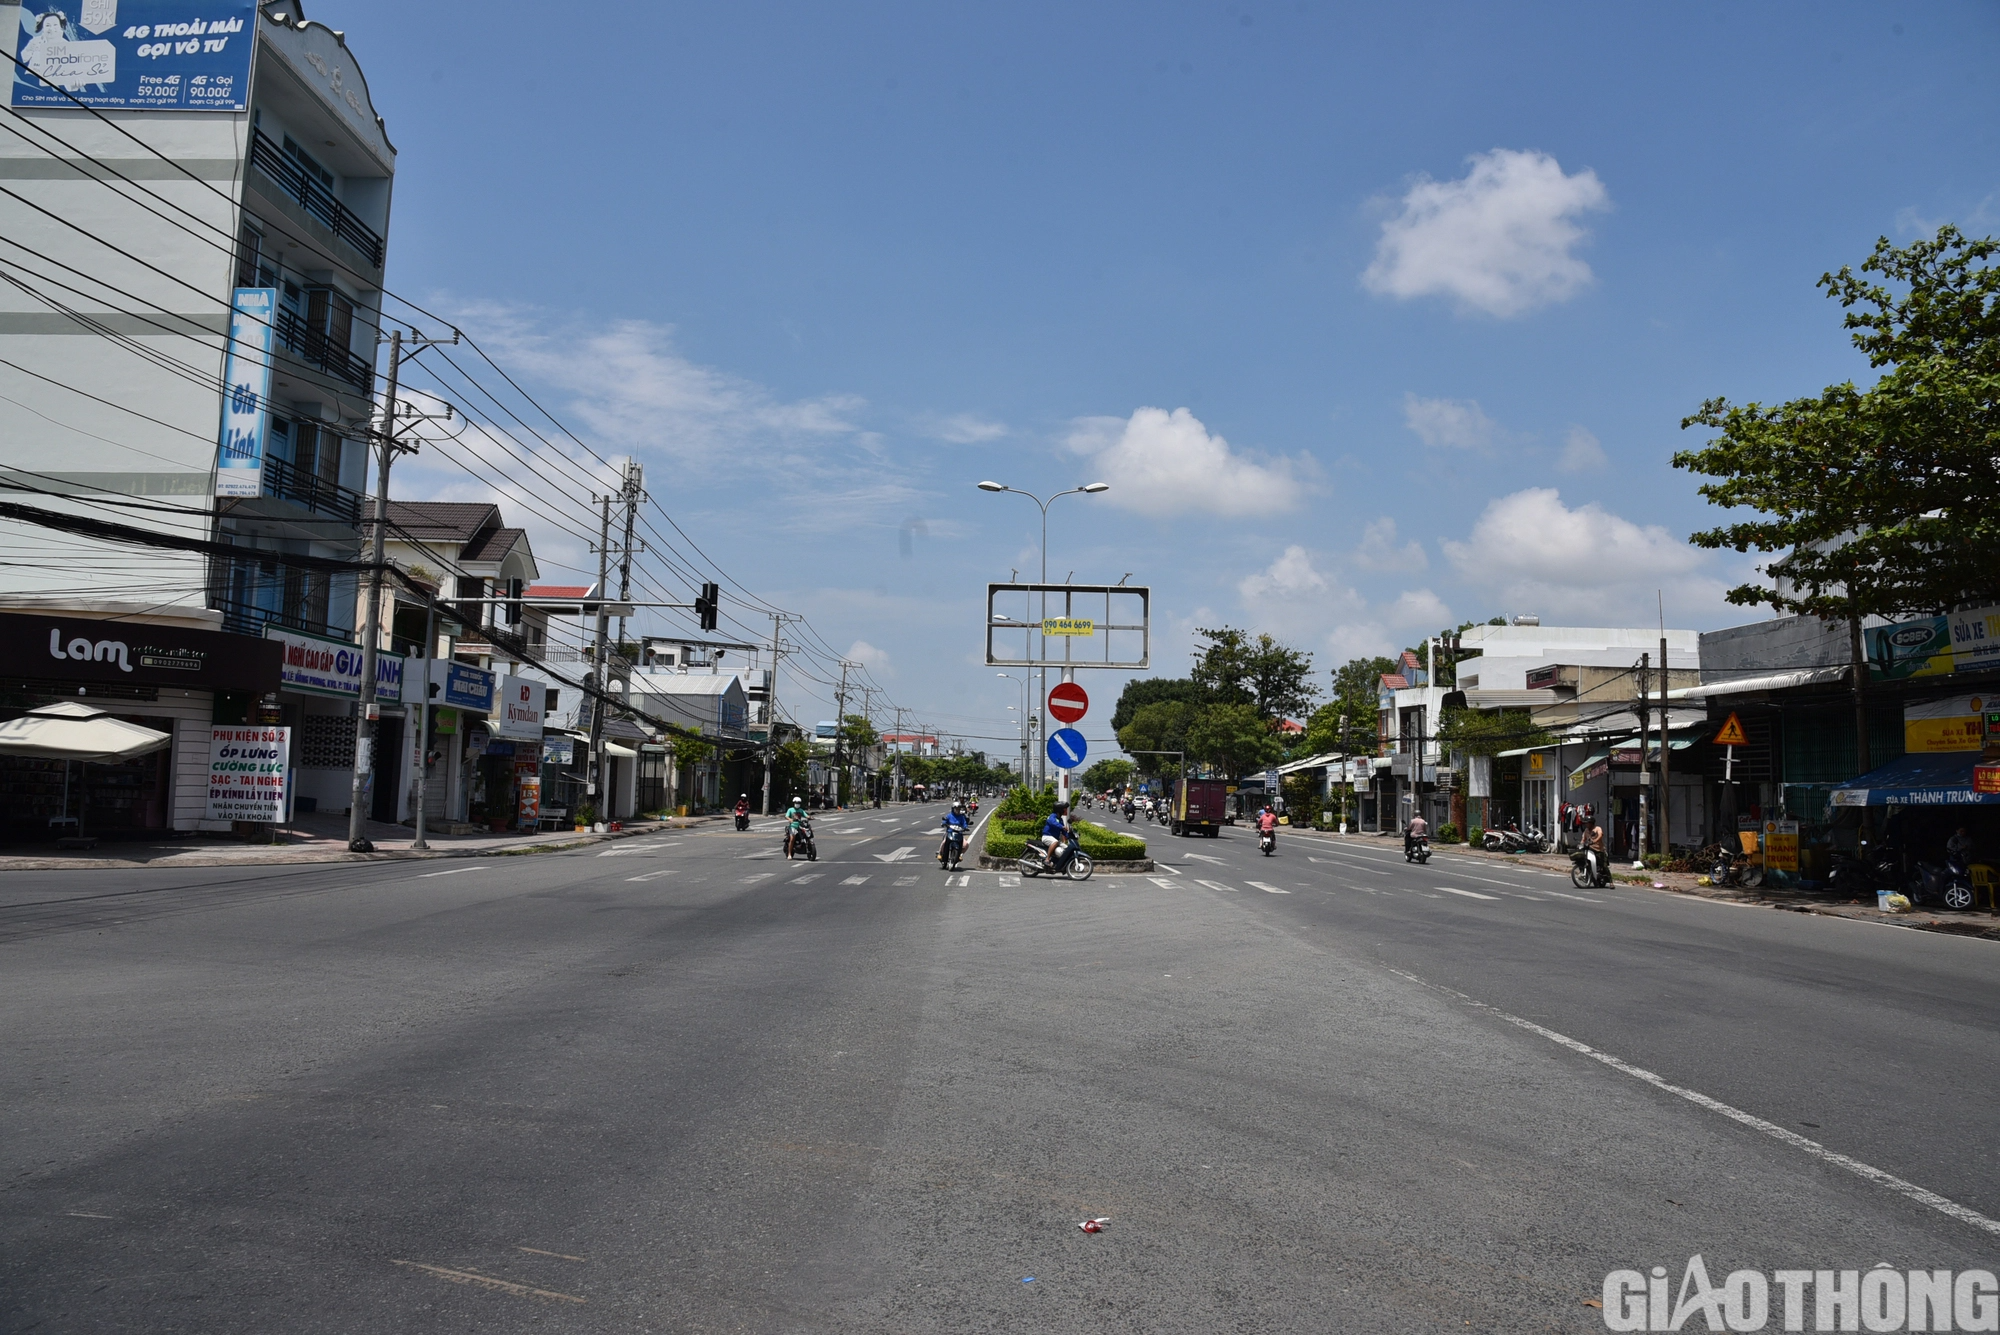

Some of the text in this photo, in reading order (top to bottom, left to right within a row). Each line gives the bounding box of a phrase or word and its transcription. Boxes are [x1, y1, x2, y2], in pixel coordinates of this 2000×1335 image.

[83, 11, 115, 25] 59K
[123, 16, 244, 39] 4G THOẢI MÁI
[46, 45, 66, 56] SIM
[137, 36, 229, 60] GỌI VÔ TƯ
[46, 53, 109, 65] mobifone
[42, 64, 83, 77] Chia
[140, 75, 181, 85] Free 4G
[190, 75, 208, 85] 4G
[216, 75, 233, 87] Gọi
[237, 292, 269, 307] NHÀ
[231, 383, 257, 415] Gia
[225, 427, 255, 460] Linh
[1044, 620, 1091, 629] 090 464 6699
[1954, 618, 1972, 643] SỬA
[1972, 621, 1985, 640] XE
[1896, 629, 1928, 644] SOBEK
[50, 628, 134, 673] Lam
[306, 649, 319, 670] CAO
[320, 646, 334, 672] CẤP
[508, 703, 539, 724] Kymdan
[213, 728, 285, 743] PHỤ KIỆN SỐ 2
[220, 744, 278, 759] ỐP LƯNG
[212, 761, 284, 775] CƯỜNG LỰC
[211, 775, 231, 786] SẠC
[239, 776, 254, 785] TAI
[257, 777, 283, 786] NGHE
[1886, 789, 1983, 805] SỬA XE THÀNH TRUNG
[1767, 855, 1796, 863] TRUNG
